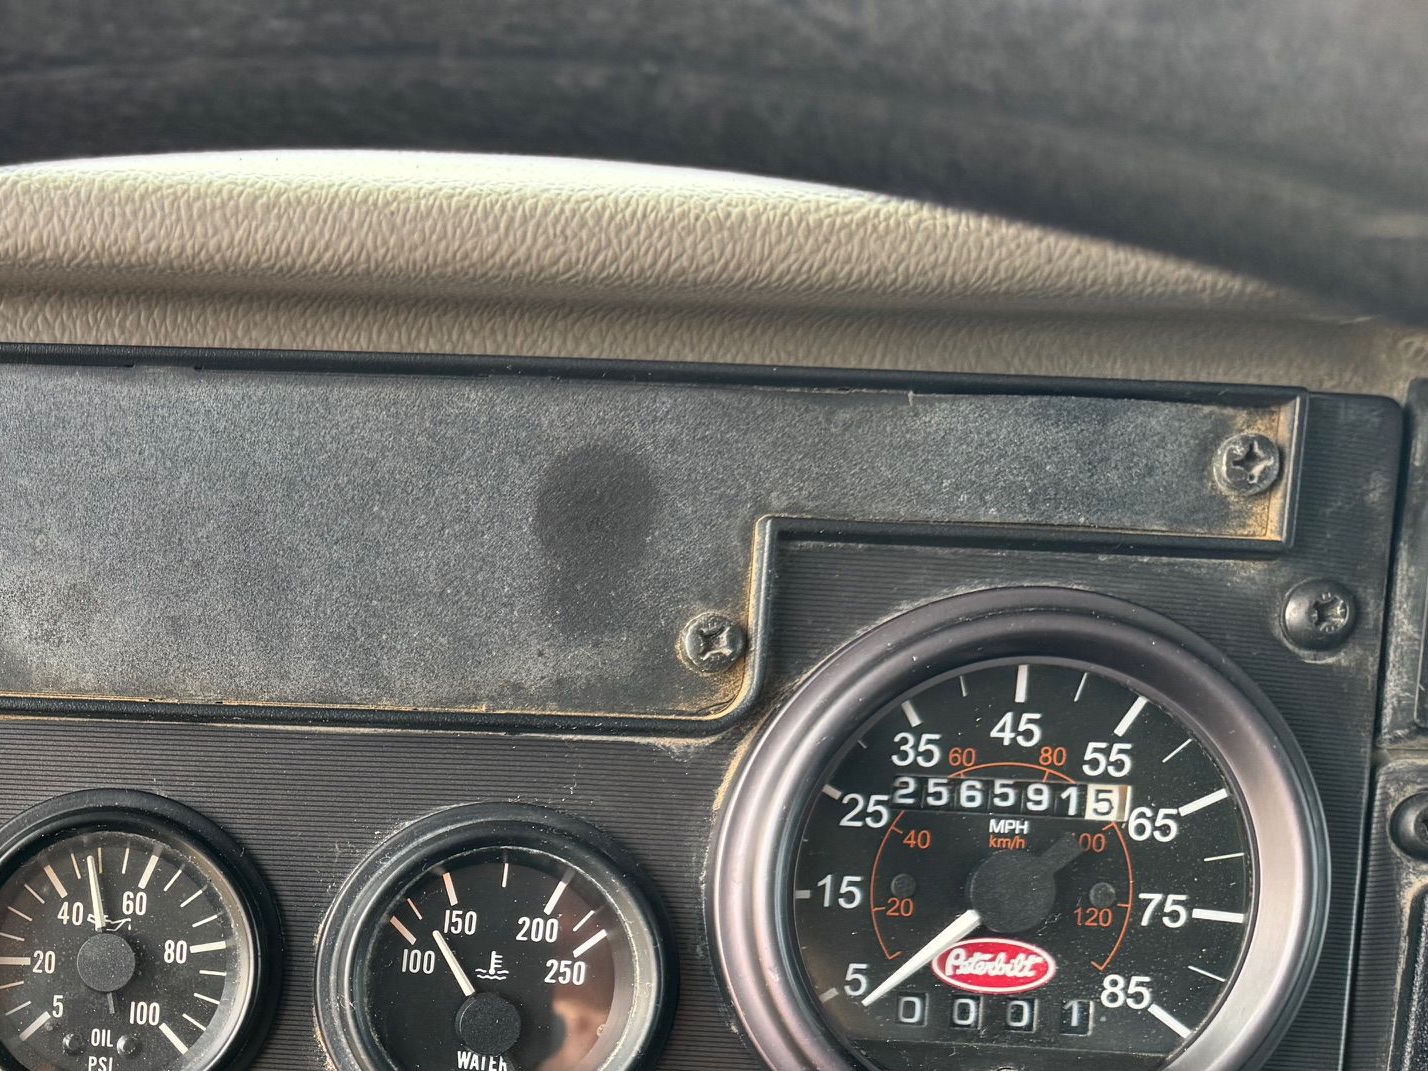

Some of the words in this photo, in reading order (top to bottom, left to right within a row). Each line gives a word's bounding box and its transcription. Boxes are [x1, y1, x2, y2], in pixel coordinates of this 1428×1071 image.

[990, 711, 1042, 747] 45
[891, 732, 942, 767] 35
[948, 747, 976, 767] 60
[1038, 747, 1067, 767] 80
[1082, 741, 1132, 777] 55
[839, 793, 890, 828] 25
[988, 819, 1030, 834] MPH
[1127, 806, 1178, 842] 65
[903, 830, 931, 849] 40
[988, 835, 1026, 849] km/h
[1075, 833, 1106, 853] 00
[122, 891, 147, 916] 60
[817, 874, 863, 909] 15
[57, 902, 84, 926] 40
[886, 898, 914, 917] 20
[1075, 907, 1113, 927] 120
[1138, 893, 1187, 928] 75
[443, 910, 477, 936] 150
[516, 917, 559, 943] 200
[32, 950, 56, 974] 20
[164, 940, 187, 964] 80
[401, 949, 435, 974] 100
[945, 948, 1043, 978] Peterbilt
[544, 959, 586, 985] 250
[844, 963, 869, 996] 5
[1100, 974, 1152, 1010] 85
[52, 995, 64, 1018] 5
[129, 1001, 160, 1025] 100
[90, 1028, 113, 1048] OIL
